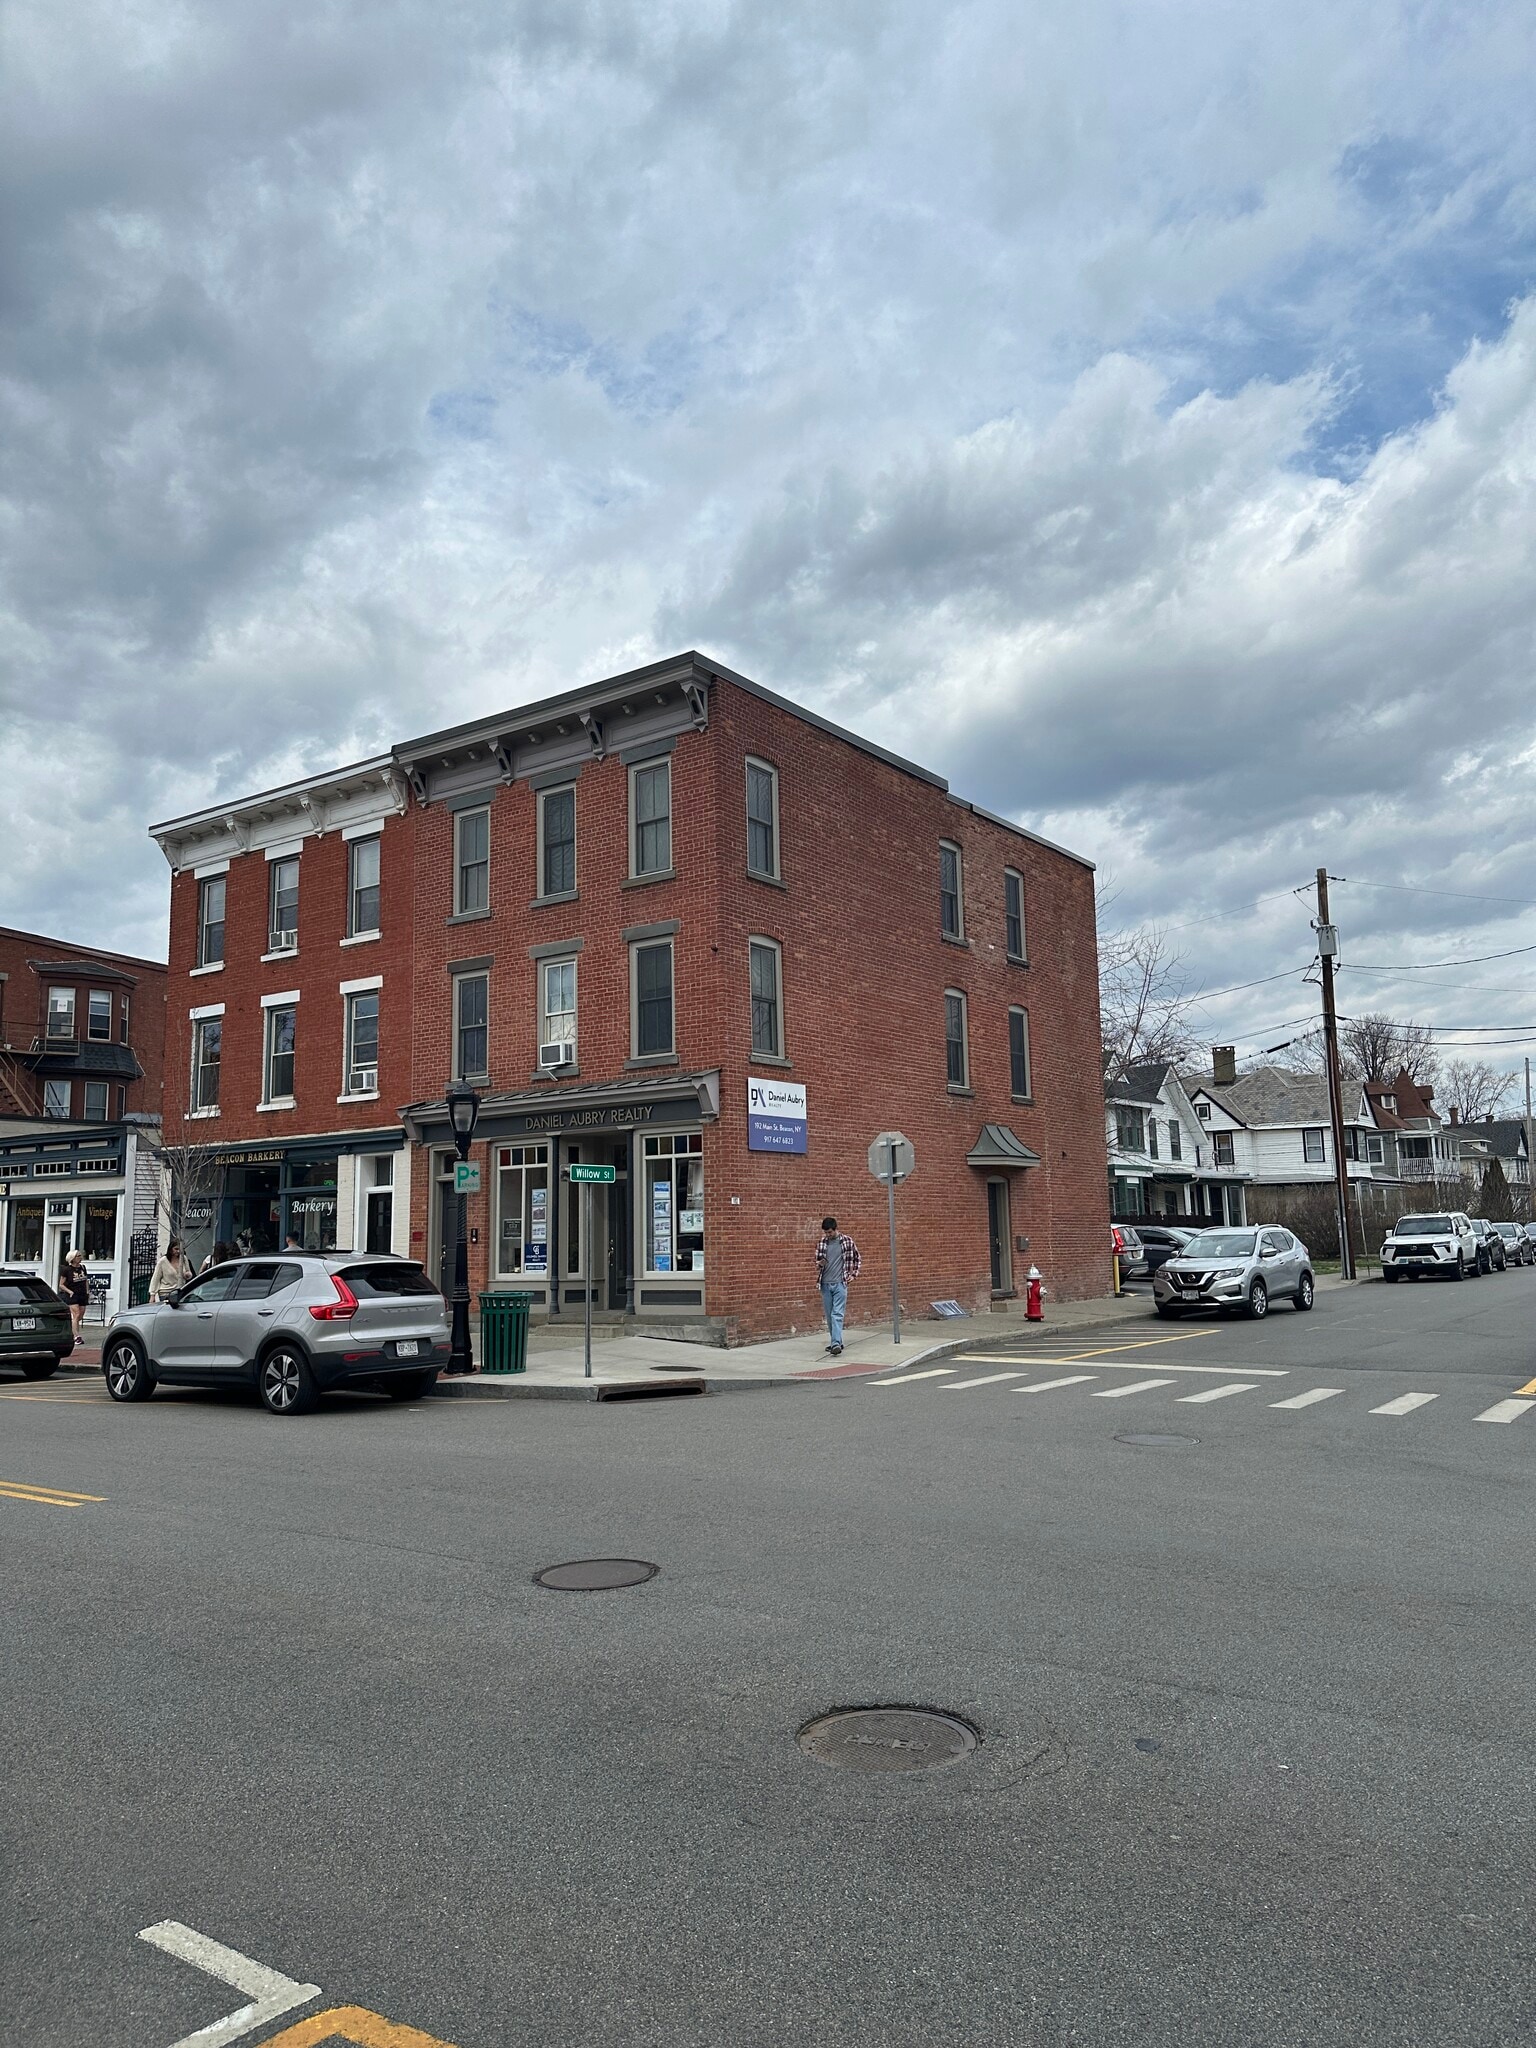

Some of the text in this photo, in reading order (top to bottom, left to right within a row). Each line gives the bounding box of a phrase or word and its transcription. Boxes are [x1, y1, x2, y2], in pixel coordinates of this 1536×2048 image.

[768, 1091, 804, 1107] Daniel Aubry
[526, 1106, 653, 1130] DANIEL AUBRY REALTY
[215, 1150, 285, 1164] BEACON BARKERY
[576, 1168, 610, 1179] Willow St
[89, 1206, 113, 1220] Vintage
[185, 1208, 212, 1218] eacon
[291, 1198, 333, 1215] Barkery
